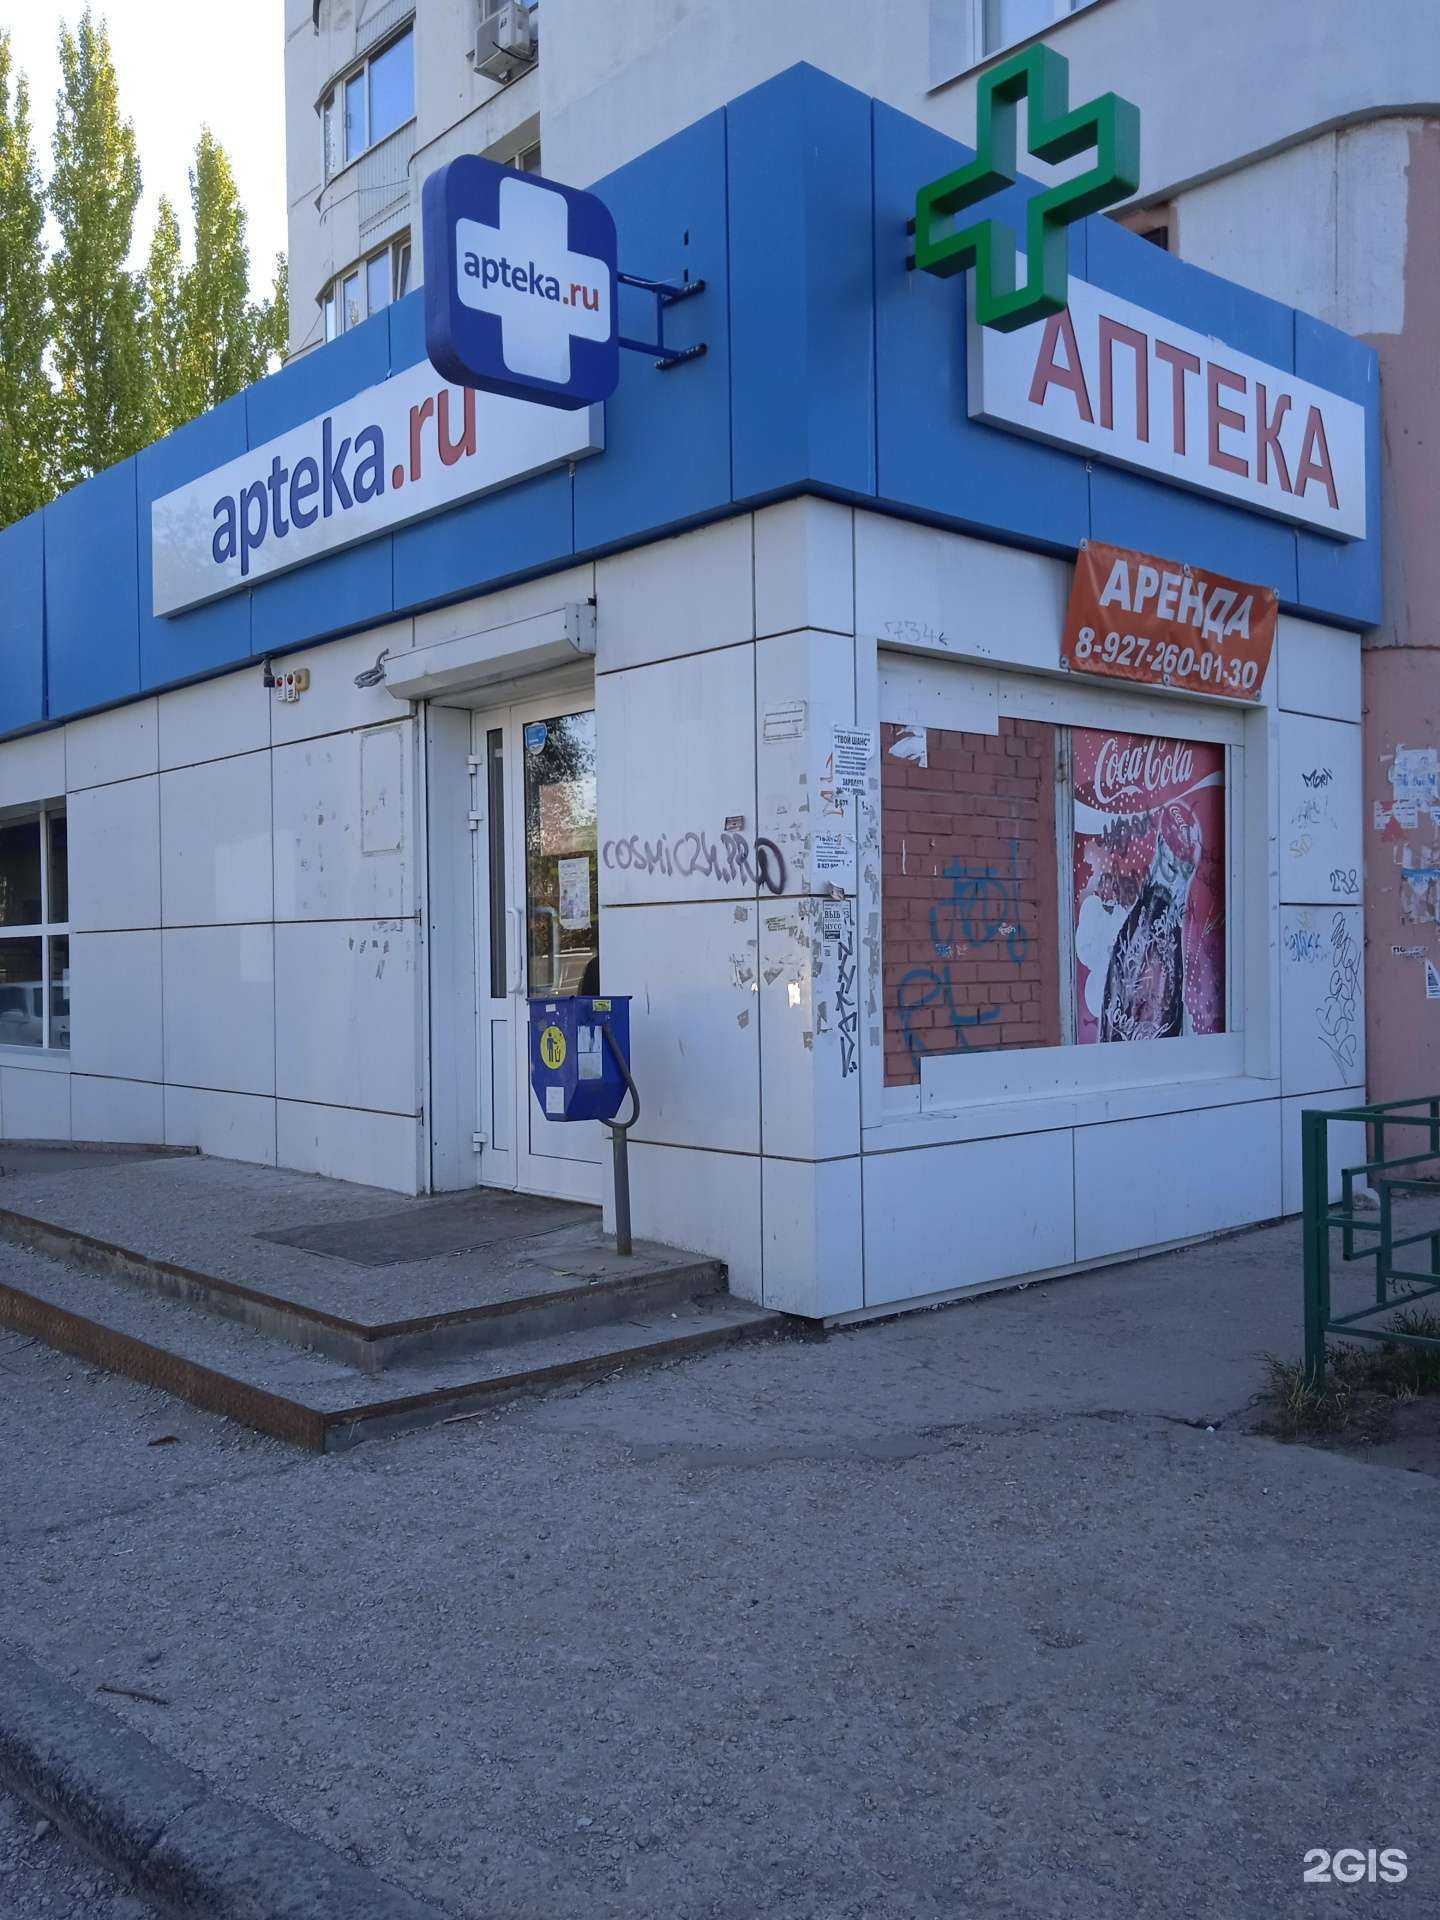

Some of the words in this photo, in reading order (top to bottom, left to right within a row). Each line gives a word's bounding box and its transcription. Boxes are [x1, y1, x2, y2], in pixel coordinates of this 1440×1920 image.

[464, 248, 600, 313] apteka.ru
[1028, 307, 1340, 510] АПТЕКА
[211, 384, 478, 576] apteka.ru
[1098, 559, 1254, 644] АРЕНДА
[1075, 626, 1258, 689] 8-927-260-01-30
[1094, 737, 1193, 804] Coca-Cola
